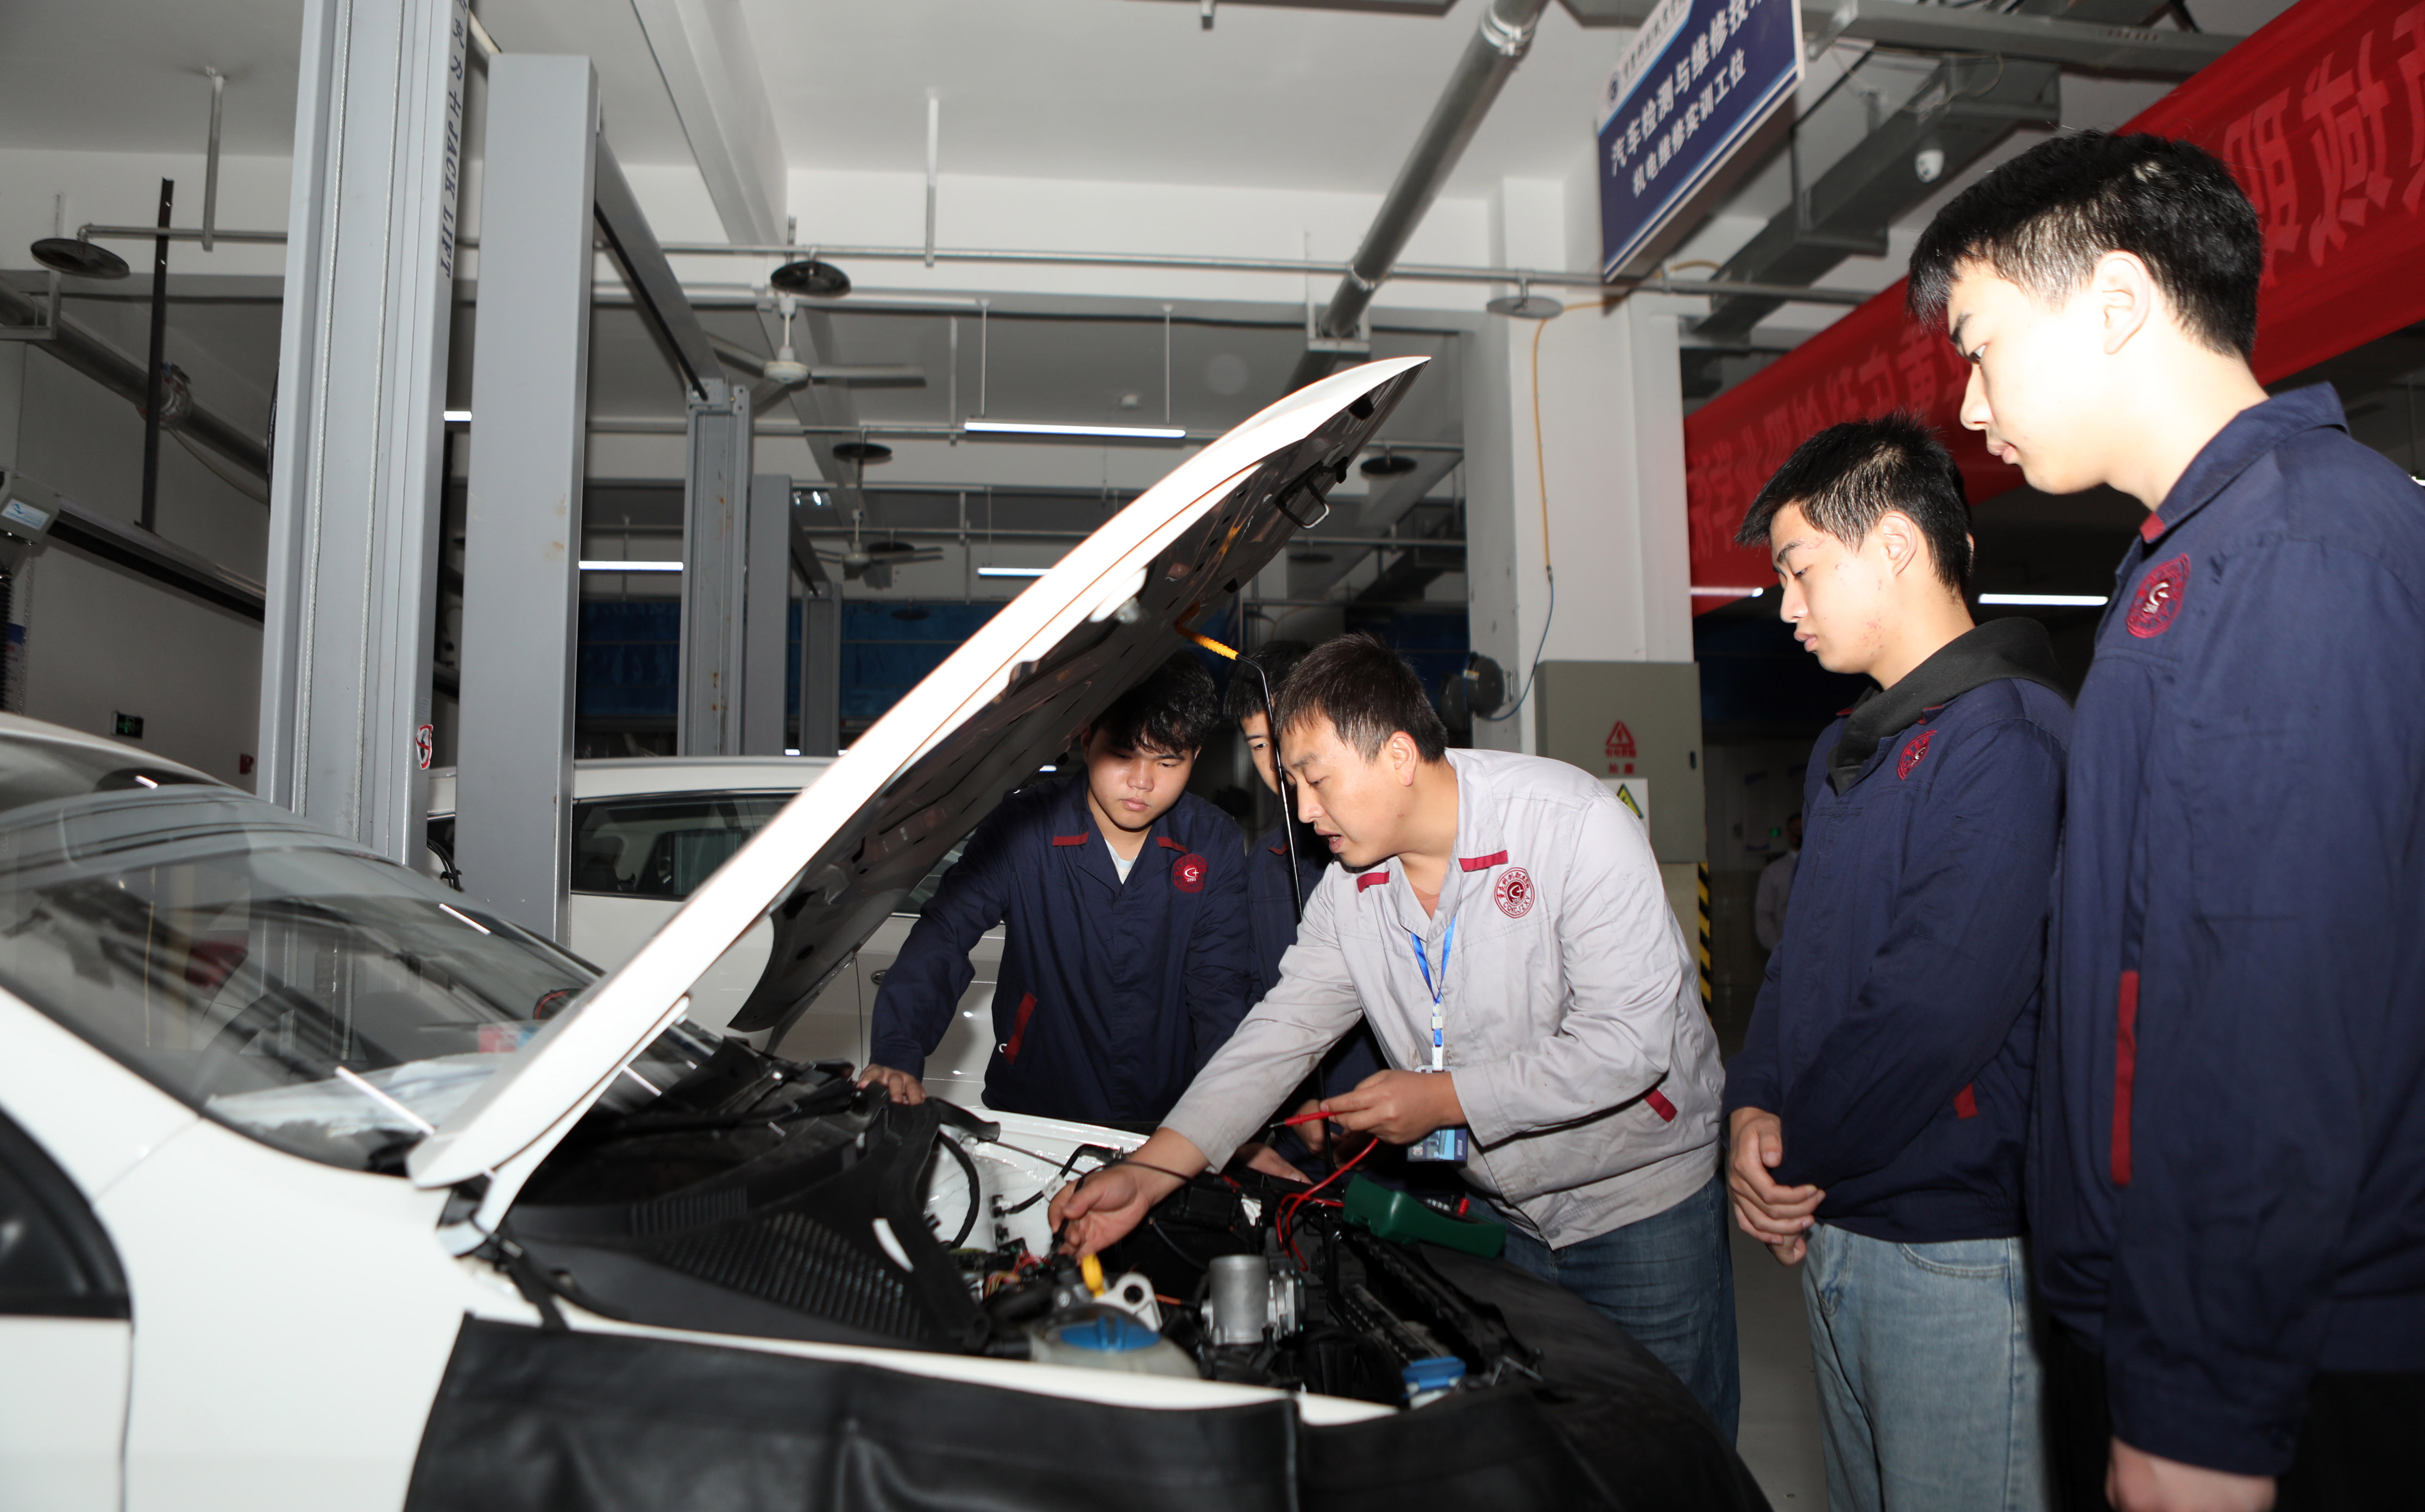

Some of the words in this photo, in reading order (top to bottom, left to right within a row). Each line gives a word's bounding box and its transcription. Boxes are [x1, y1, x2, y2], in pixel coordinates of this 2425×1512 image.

[444, 120, 460, 200] JACK
[1632, 48, 1746, 199] 机电维修实训工位
[439, 205, 454, 280] LIFT
